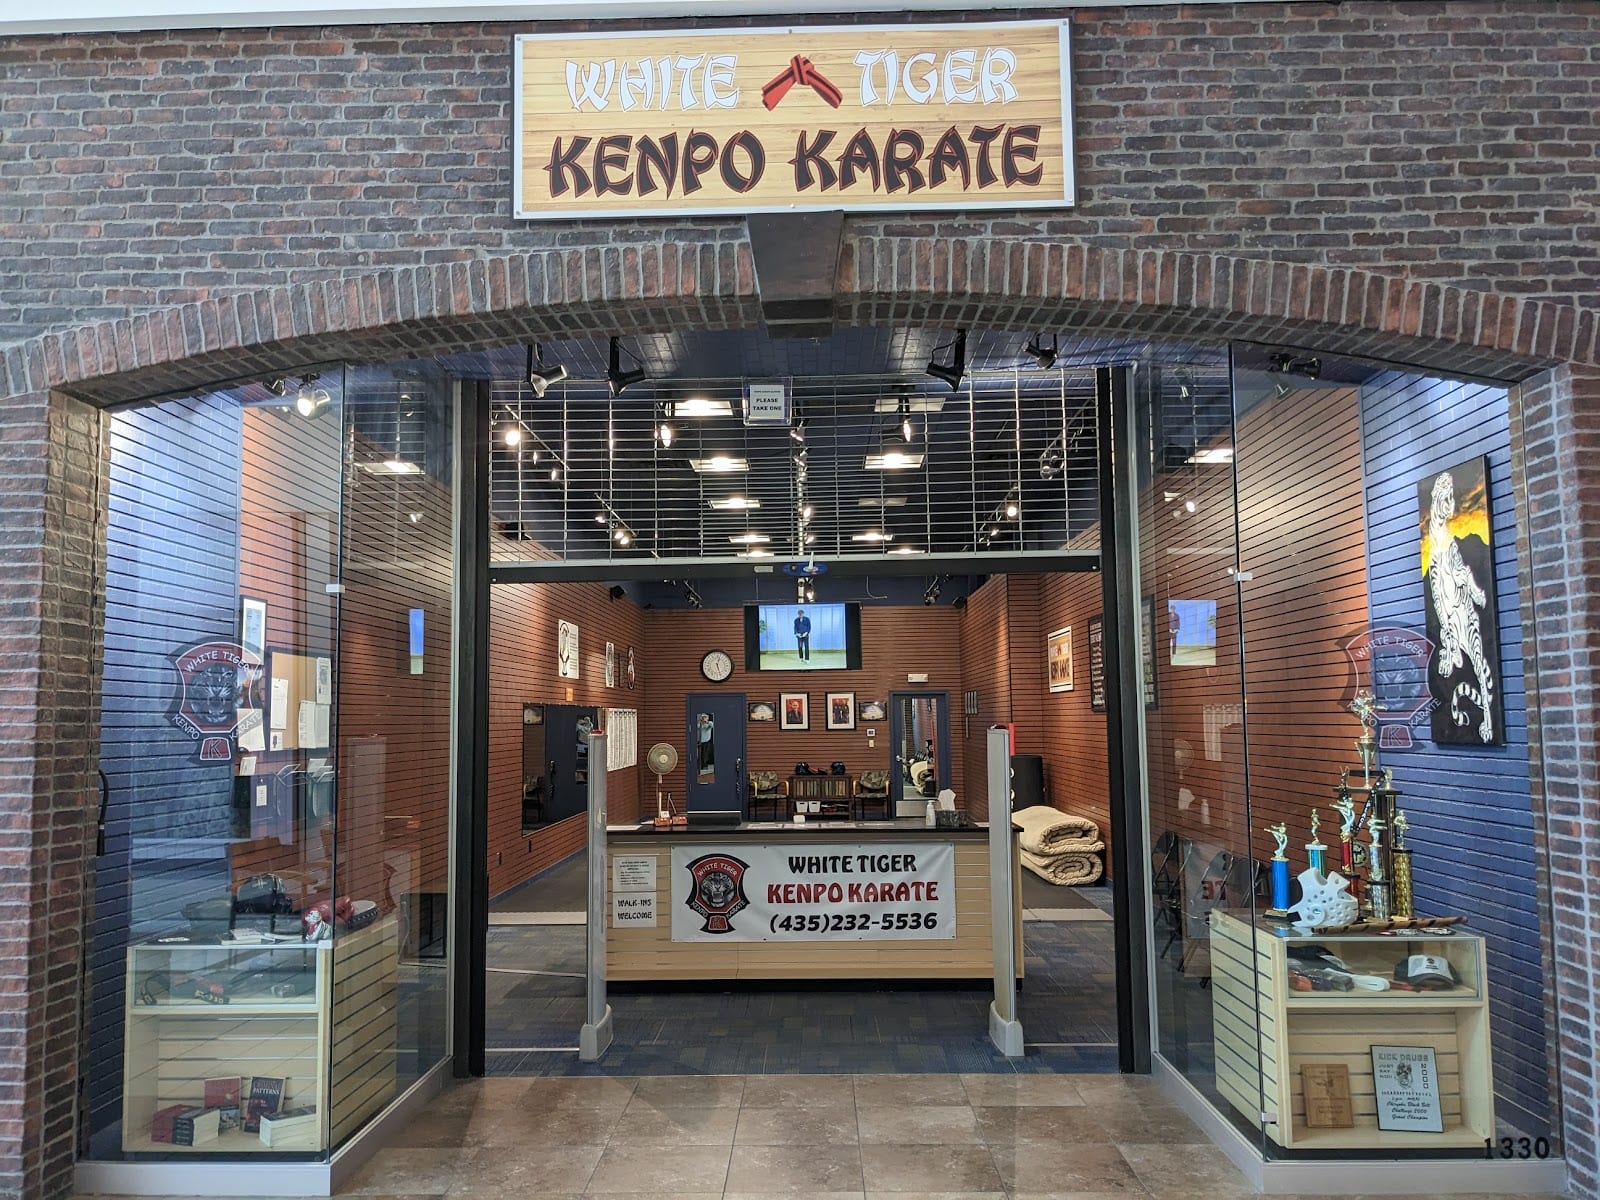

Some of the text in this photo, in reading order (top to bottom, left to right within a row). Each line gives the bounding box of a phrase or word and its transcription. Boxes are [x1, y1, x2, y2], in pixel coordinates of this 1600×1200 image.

[564, 47, 1018, 112] WHITE TIGER
[543, 124, 1044, 199] KENPO KARATE
[1355, 635, 1424, 658] WHITE TIGER
[184, 650, 250, 673] WHITE TIGER
[1408, 697, 1442, 728] KARATE
[172, 714, 200, 740] KENPO
[697, 862, 738, 876] WHITE TIGER
[788, 854, 917, 874] WHITE TIGER
[617, 898, 652, 907] WALK-INS
[767, 881, 939, 904] KENPO KARATE
[617, 911, 652, 920] WELCOME
[770, 912, 938, 933] (435)232-5536
[1484, 1137, 1550, 1159] 1330
